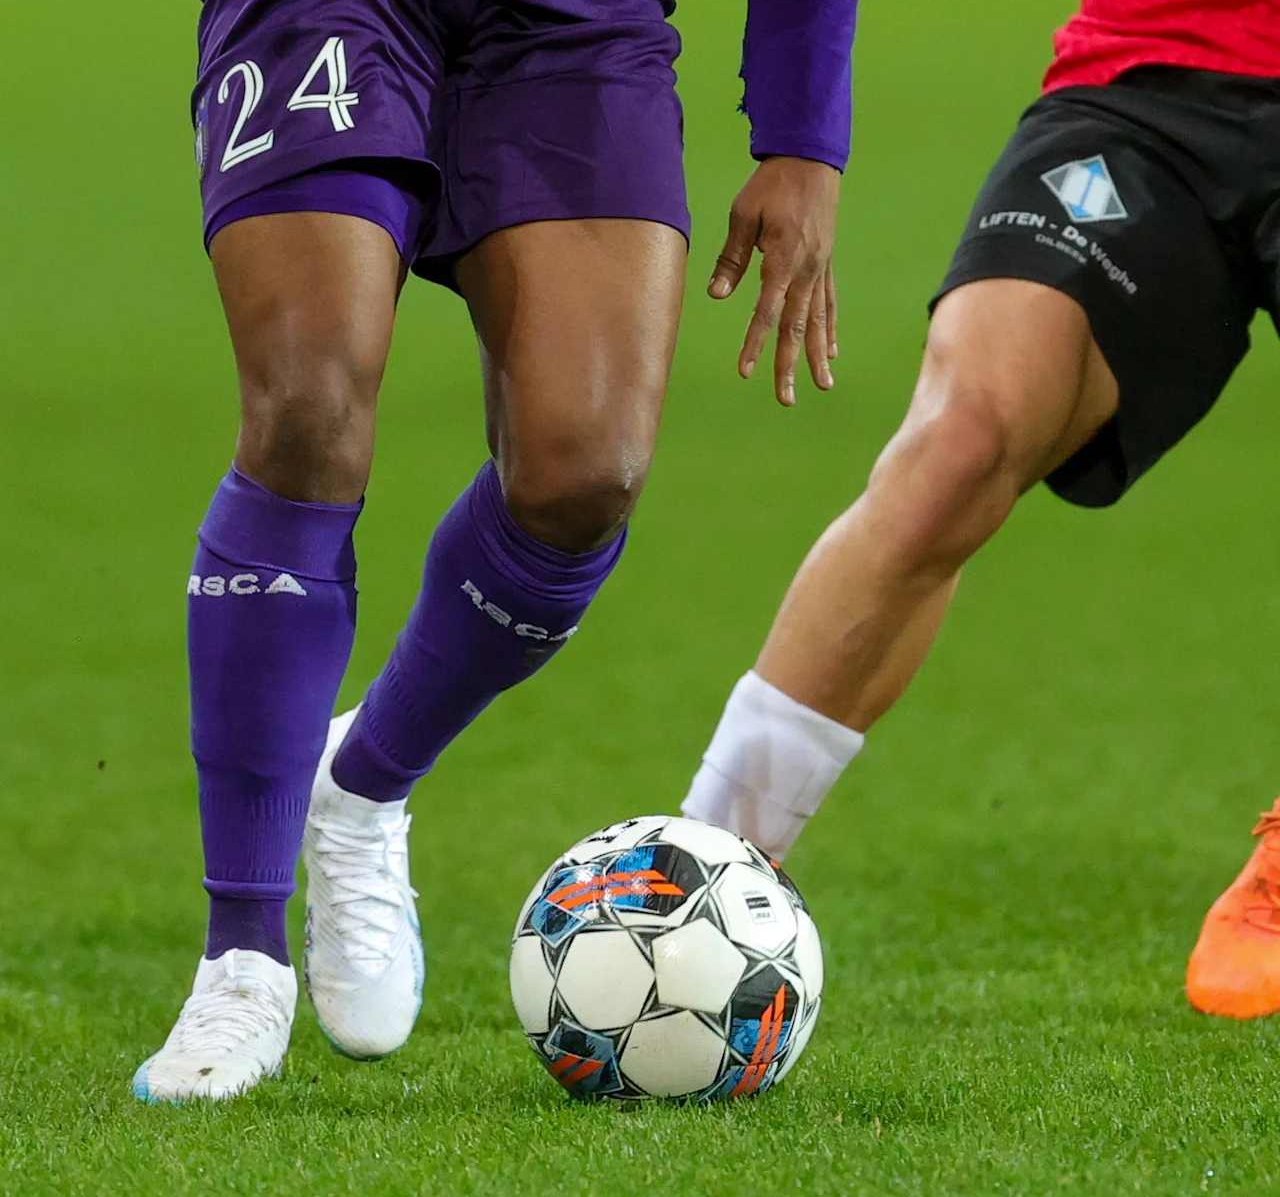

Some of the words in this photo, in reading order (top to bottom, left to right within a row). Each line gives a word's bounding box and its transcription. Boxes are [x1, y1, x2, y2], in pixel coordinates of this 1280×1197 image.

[217, 36, 360, 173] 24
[978, 211, 1047, 229] LIFTEN
[1061, 224, 1088, 247] De
[187, 573, 308, 596] RSCA
